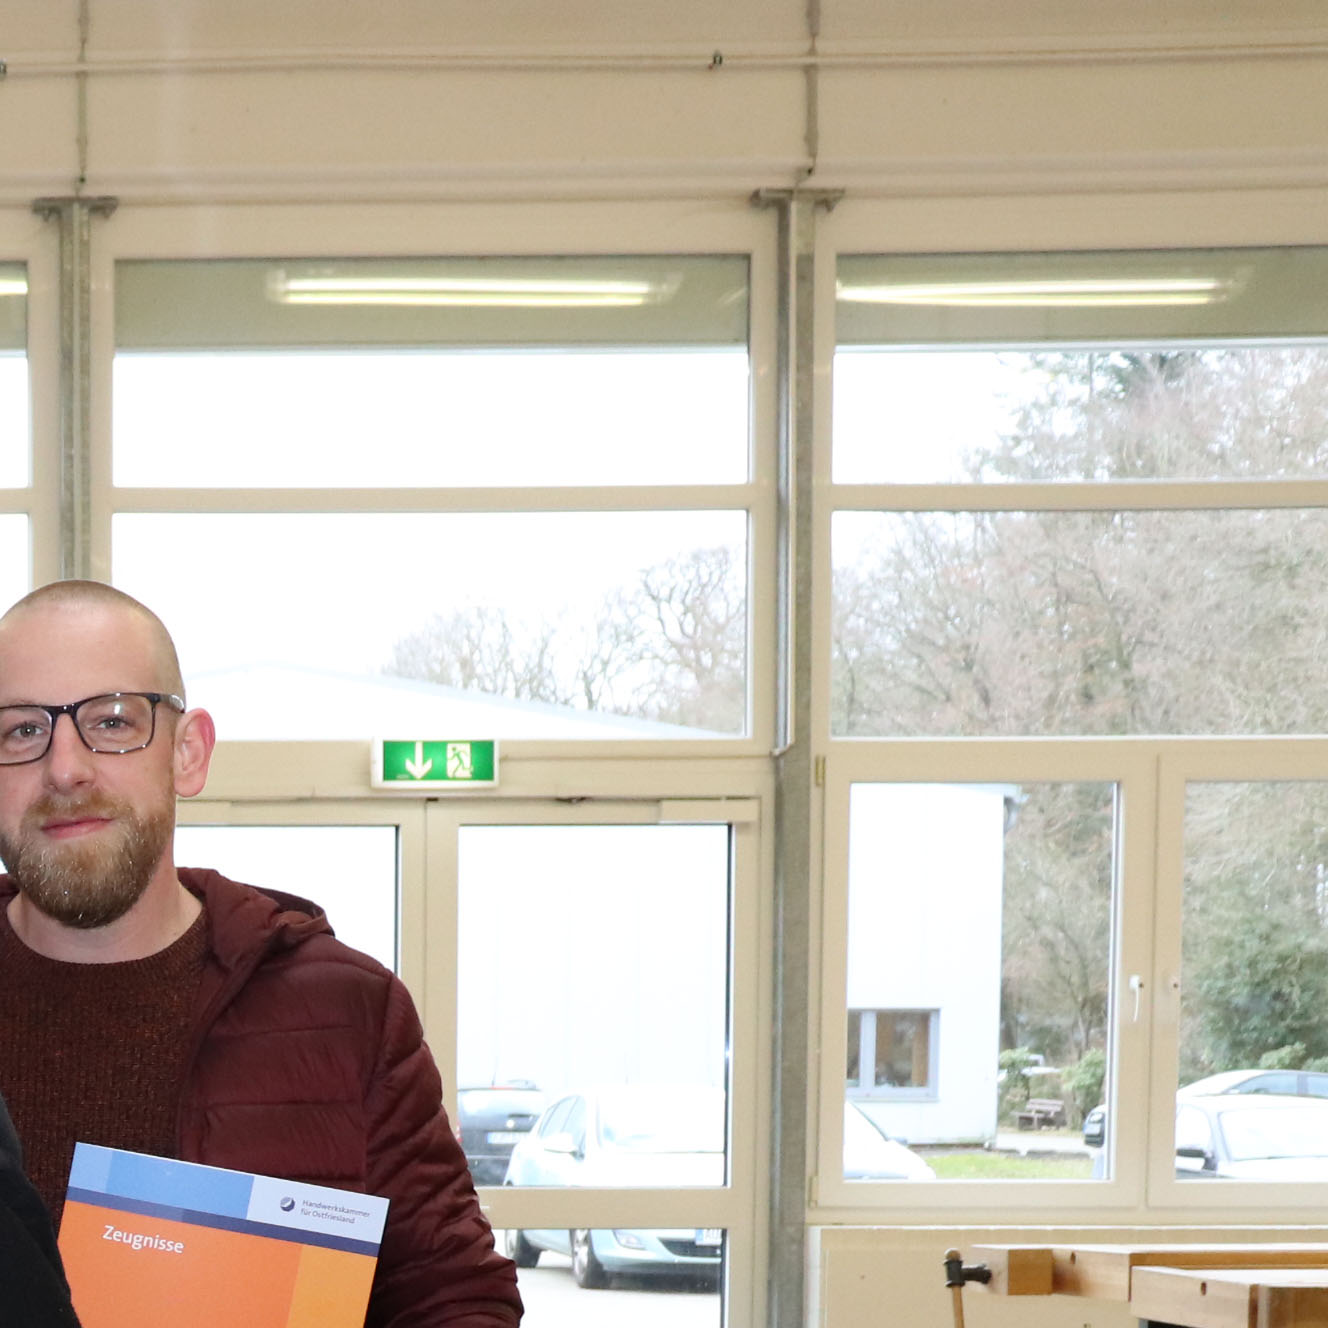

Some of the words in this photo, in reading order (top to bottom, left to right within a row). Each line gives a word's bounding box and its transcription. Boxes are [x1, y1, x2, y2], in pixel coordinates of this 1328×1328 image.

[300, 1207, 311, 1217] für
[312, 1209, 356, 1224] Ostfriesland
[302, 1199, 371, 1218] Handwerkskammer
[102, 1224, 184, 1254] Zeugnisse
